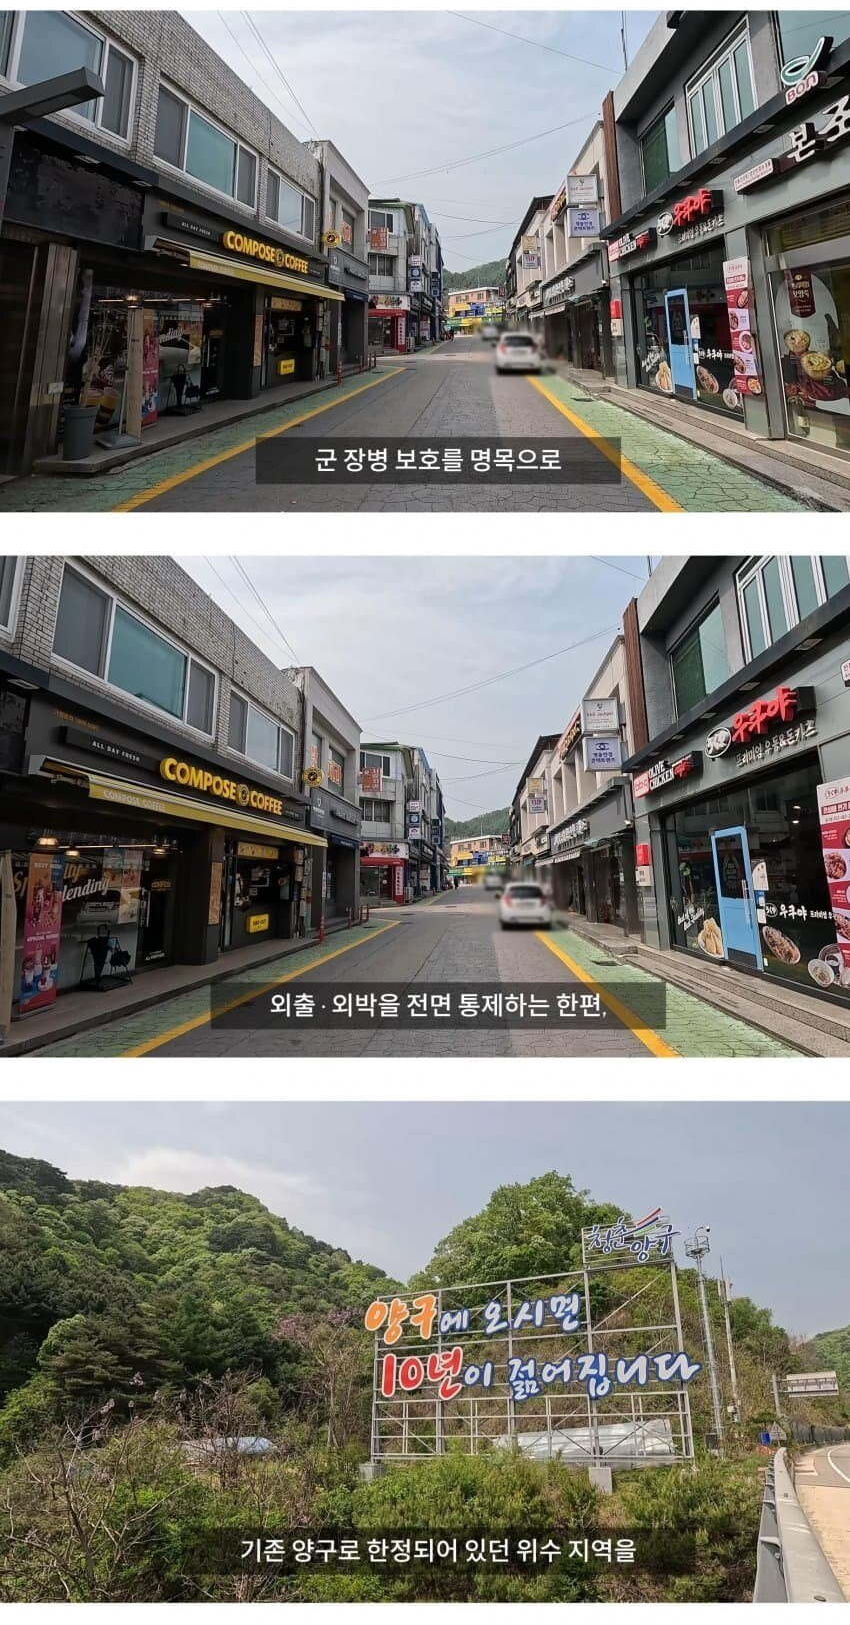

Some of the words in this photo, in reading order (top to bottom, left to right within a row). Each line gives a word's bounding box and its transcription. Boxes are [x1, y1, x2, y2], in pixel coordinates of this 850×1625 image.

[223, 230, 276, 263] COMPOSE
[284, 253, 309, 274] COFFEE
[731, 686, 799, 743] 우쿠야
[91, 740, 104, 750] ALL
[107, 745, 120, 756] DAY
[648, 760, 666, 779] OLIVE
[159, 756, 237, 800] COMPOSE
[248, 790, 283, 817] COFFEE
[649, 768, 675, 791] CHICKEN
[62, 878, 110, 902] lending
[779, 903, 808, 921] 우쿠야
[586, 1217, 630, 1254] 청춘
[629, 1224, 682, 1262] 양구
[364, 1294, 471, 1345] 양구에
[483, 1292, 582, 1336] 오시면
[382, 1346, 495, 1401] 10년이
[507, 1352, 702, 1402] 젊어집니다
